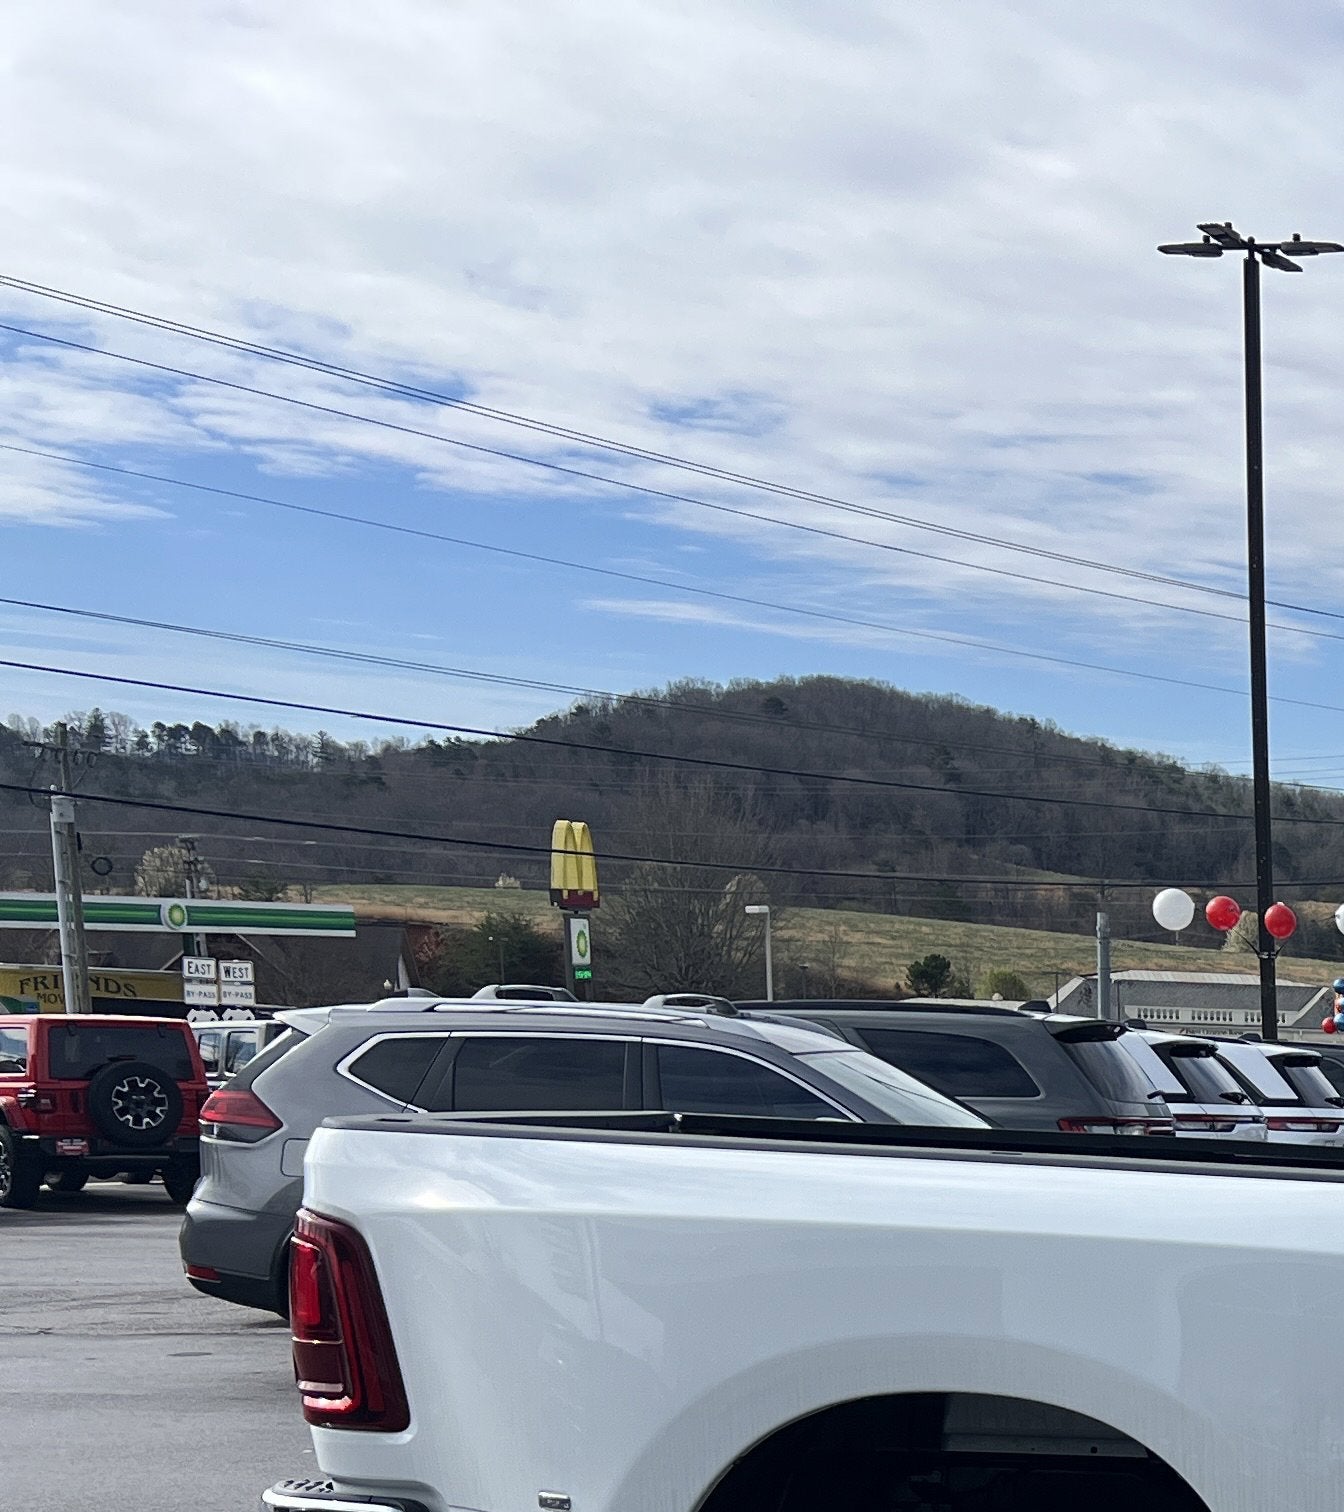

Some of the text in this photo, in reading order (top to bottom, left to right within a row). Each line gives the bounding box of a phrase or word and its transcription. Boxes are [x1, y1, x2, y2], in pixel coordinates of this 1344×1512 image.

[187, 961, 212, 975] EAST
[223, 965, 249, 979] WEST
[19, 974, 136, 998] FRINDS
